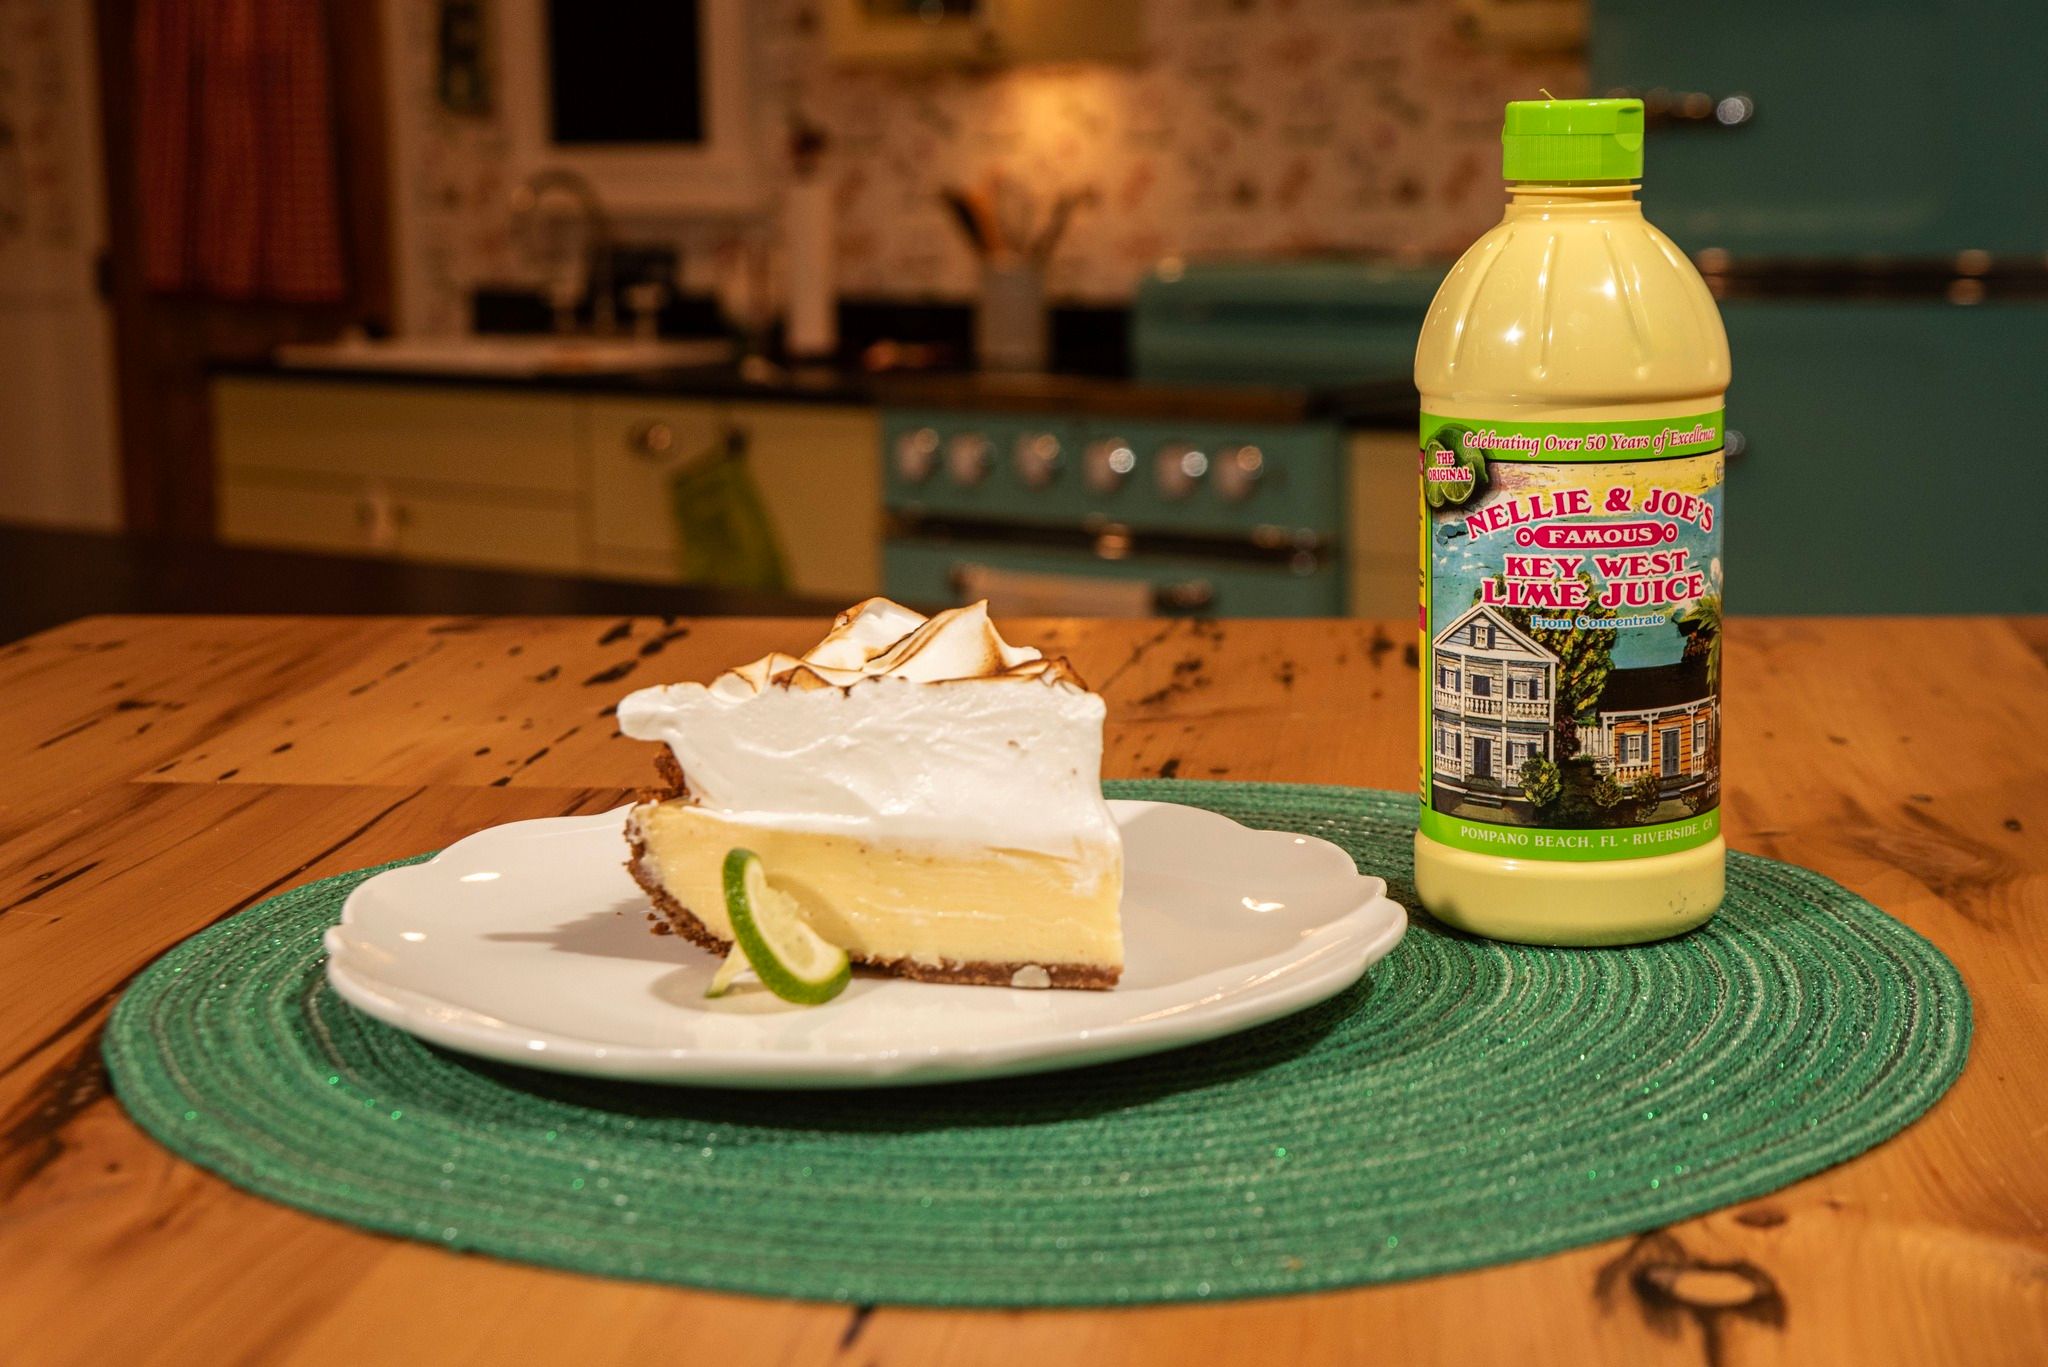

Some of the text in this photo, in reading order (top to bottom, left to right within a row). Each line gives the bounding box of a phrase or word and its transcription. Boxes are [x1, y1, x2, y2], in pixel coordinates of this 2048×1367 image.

[1463, 424, 1716, 457] Celebrating Over 50 Years of Excellence
[1436, 451, 1454, 465] THE
[1428, 466, 1472, 481] ORIGINAL
[1466, 487, 1714, 539] NELLIE & JOE'S
[1549, 528, 1653, 544] FAMOUS
[1506, 551, 1689, 578] KEY WEST
[1481, 574, 1704, 608] LIME JUICE
[1531, 615, 1665, 629] From Concentrate
[1461, 826, 1528, 846] POMPANO
[1535, 835, 1595, 849] BEACH,
[1600, 835, 1618, 847] FL
[1703, 817, 1713, 831] CA
